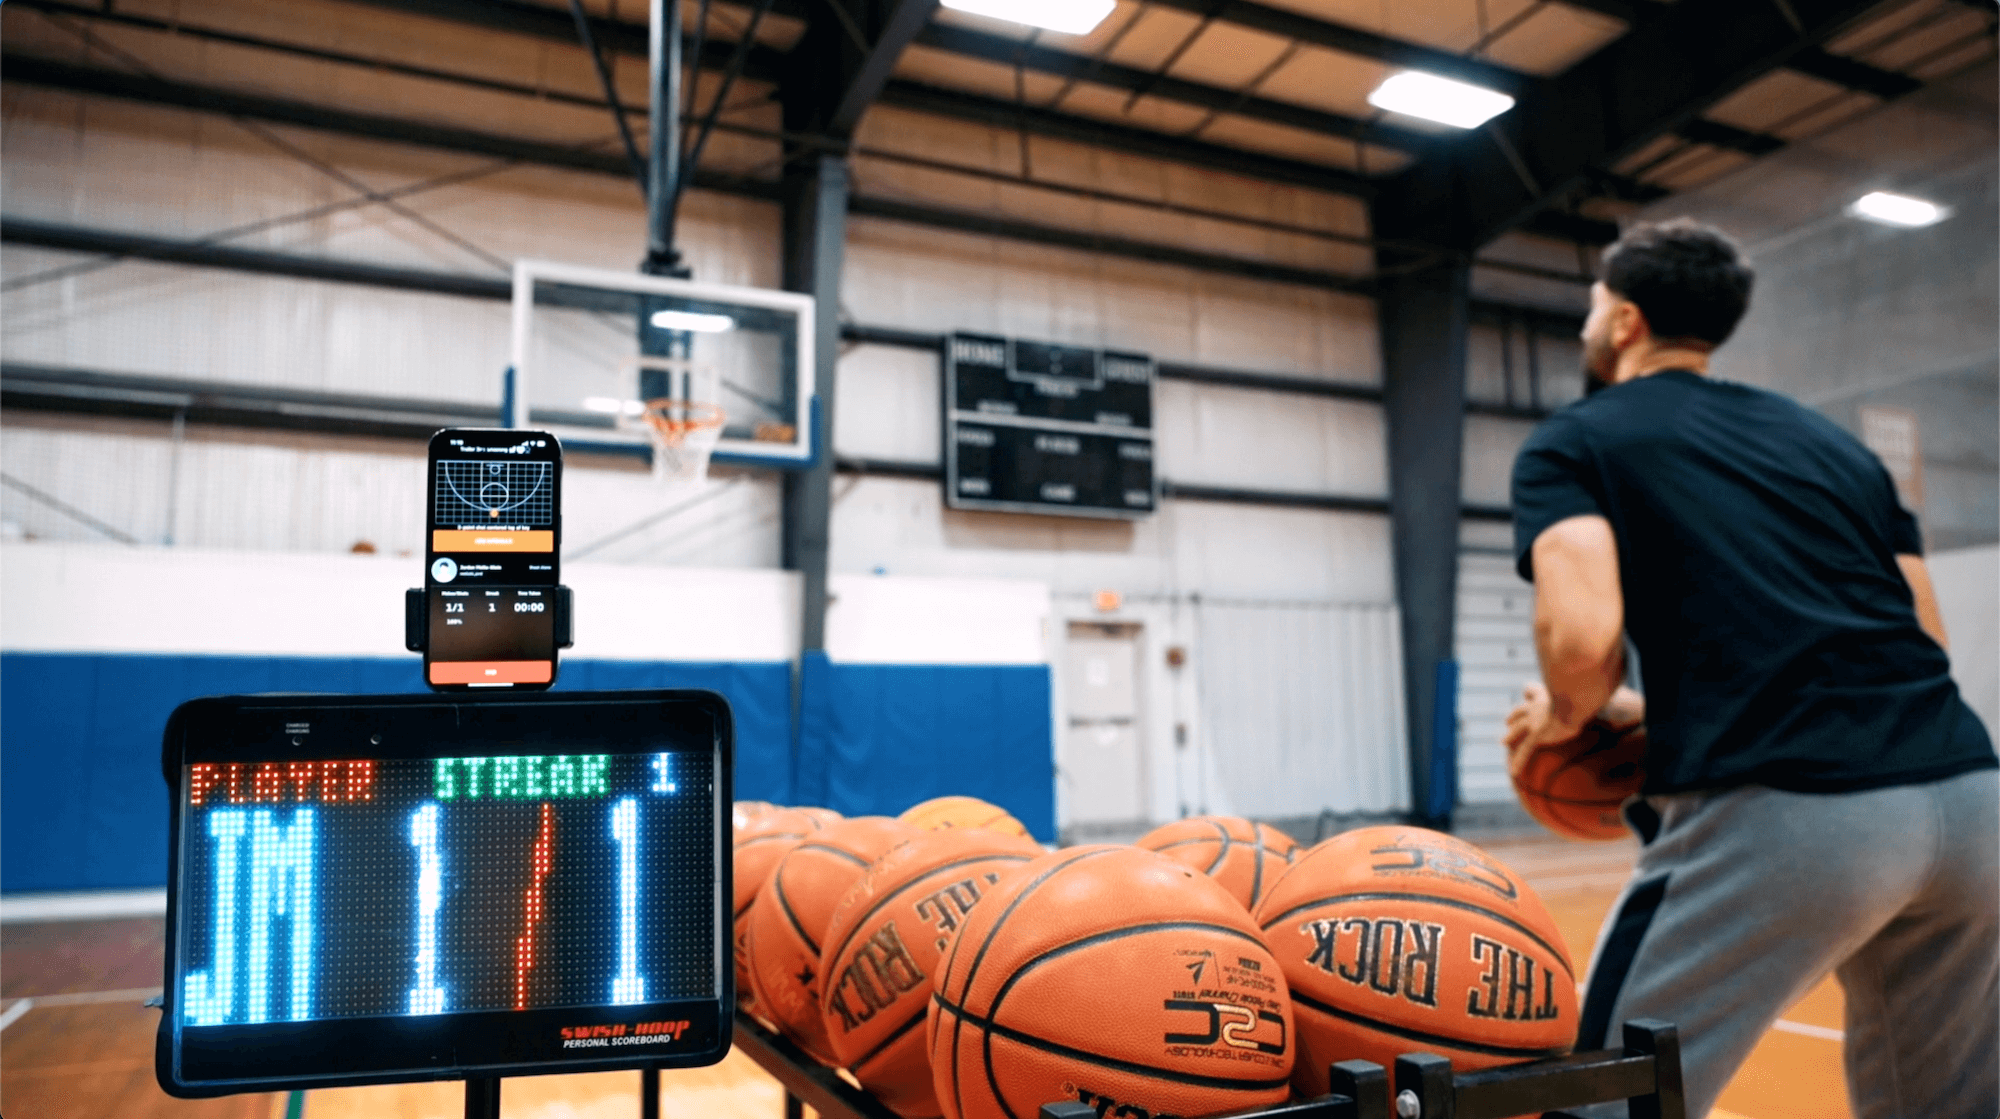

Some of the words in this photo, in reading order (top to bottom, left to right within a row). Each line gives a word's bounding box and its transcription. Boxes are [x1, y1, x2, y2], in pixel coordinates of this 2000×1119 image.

[445, 603, 465, 613] 1/1
[488, 603, 496, 613] 1
[514, 602, 545, 613] 00:00
[191, 761, 372, 805] PLAYER
[435, 756, 610, 799] STREAK
[652, 752, 677, 793] 1
[183, 808, 314, 1026] JM
[827, 919, 927, 1035] ROCK
[1300, 915, 1444, 1009] ROCK
[1465, 932, 1560, 1023] THE
[563, 1036, 610, 1049] PERSONAL
[610, 1033, 672, 1047] SCOREBOARD
